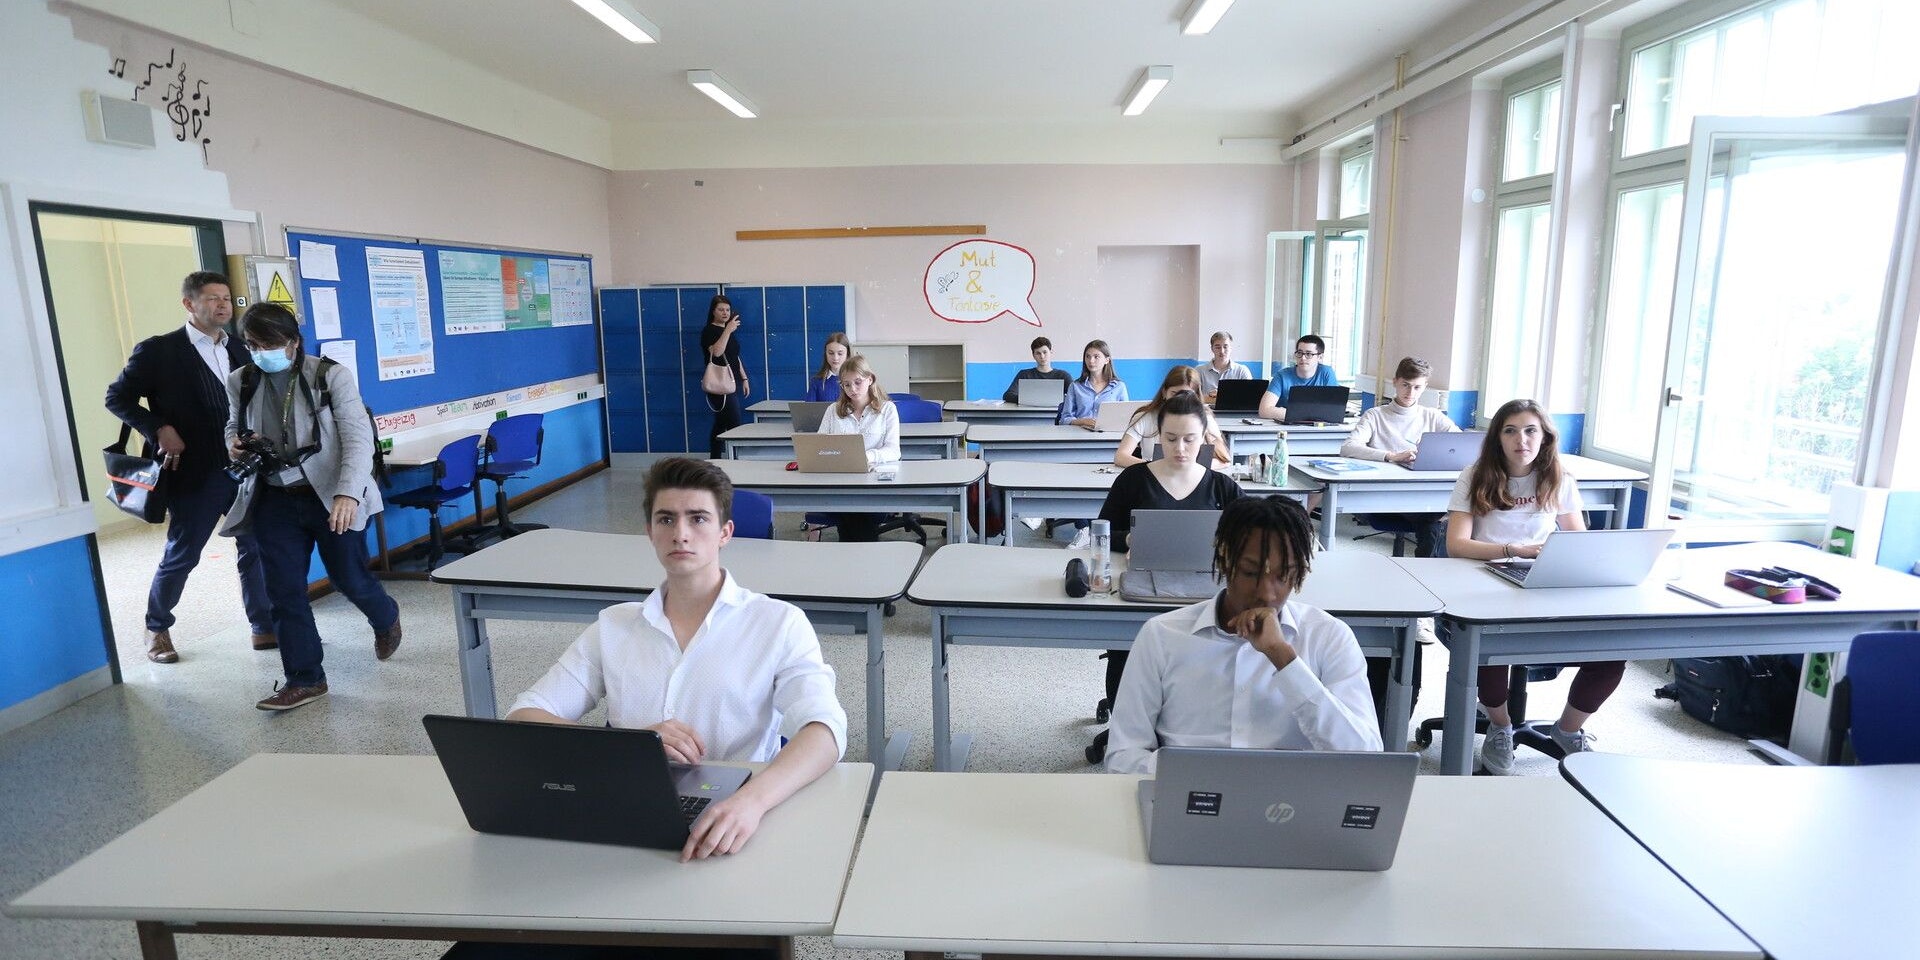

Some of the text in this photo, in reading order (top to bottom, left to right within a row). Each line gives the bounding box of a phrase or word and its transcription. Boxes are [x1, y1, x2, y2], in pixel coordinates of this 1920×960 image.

[960, 250, 996, 267] Mut
[966, 270, 983, 293] &
[376, 413, 416, 430] Ehrgeizig
[543, 783, 576, 791] ASUS
[1266, 803, 1295, 823] hp
